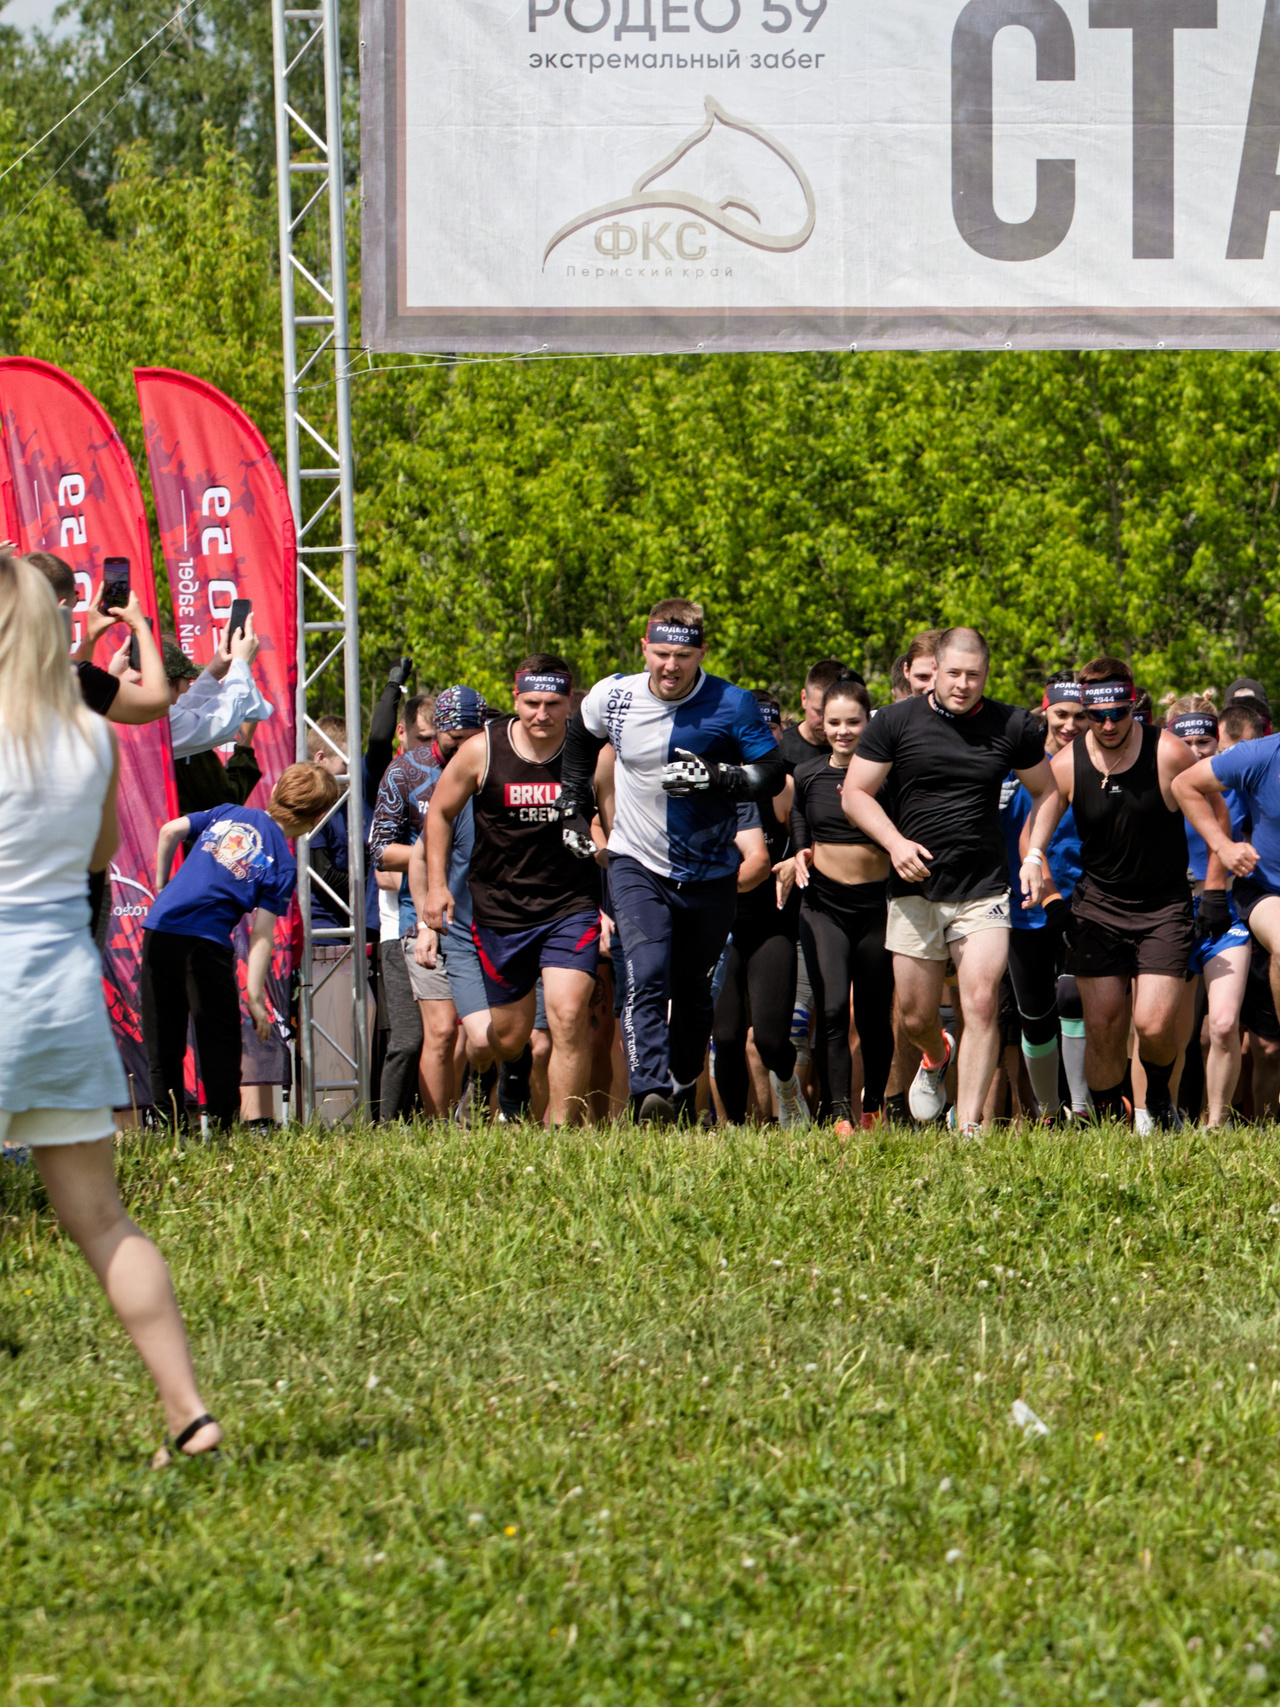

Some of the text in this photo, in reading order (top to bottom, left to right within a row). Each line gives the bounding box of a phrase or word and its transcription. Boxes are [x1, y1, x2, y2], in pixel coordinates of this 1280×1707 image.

[528, 0, 828, 42] РОДЕО 59
[529, 48, 826, 73] экстремальный забег
[594, 221, 708, 261] ФКС
[566, 265, 733, 279] Пермский край
[656, 626, 689, 634] РОДЕО
[666, 634, 690, 643] 3262
[524, 675, 555, 683] РОДЕО
[533, 683, 557, 692] 2750
[519, 807, 560, 823] CREW
